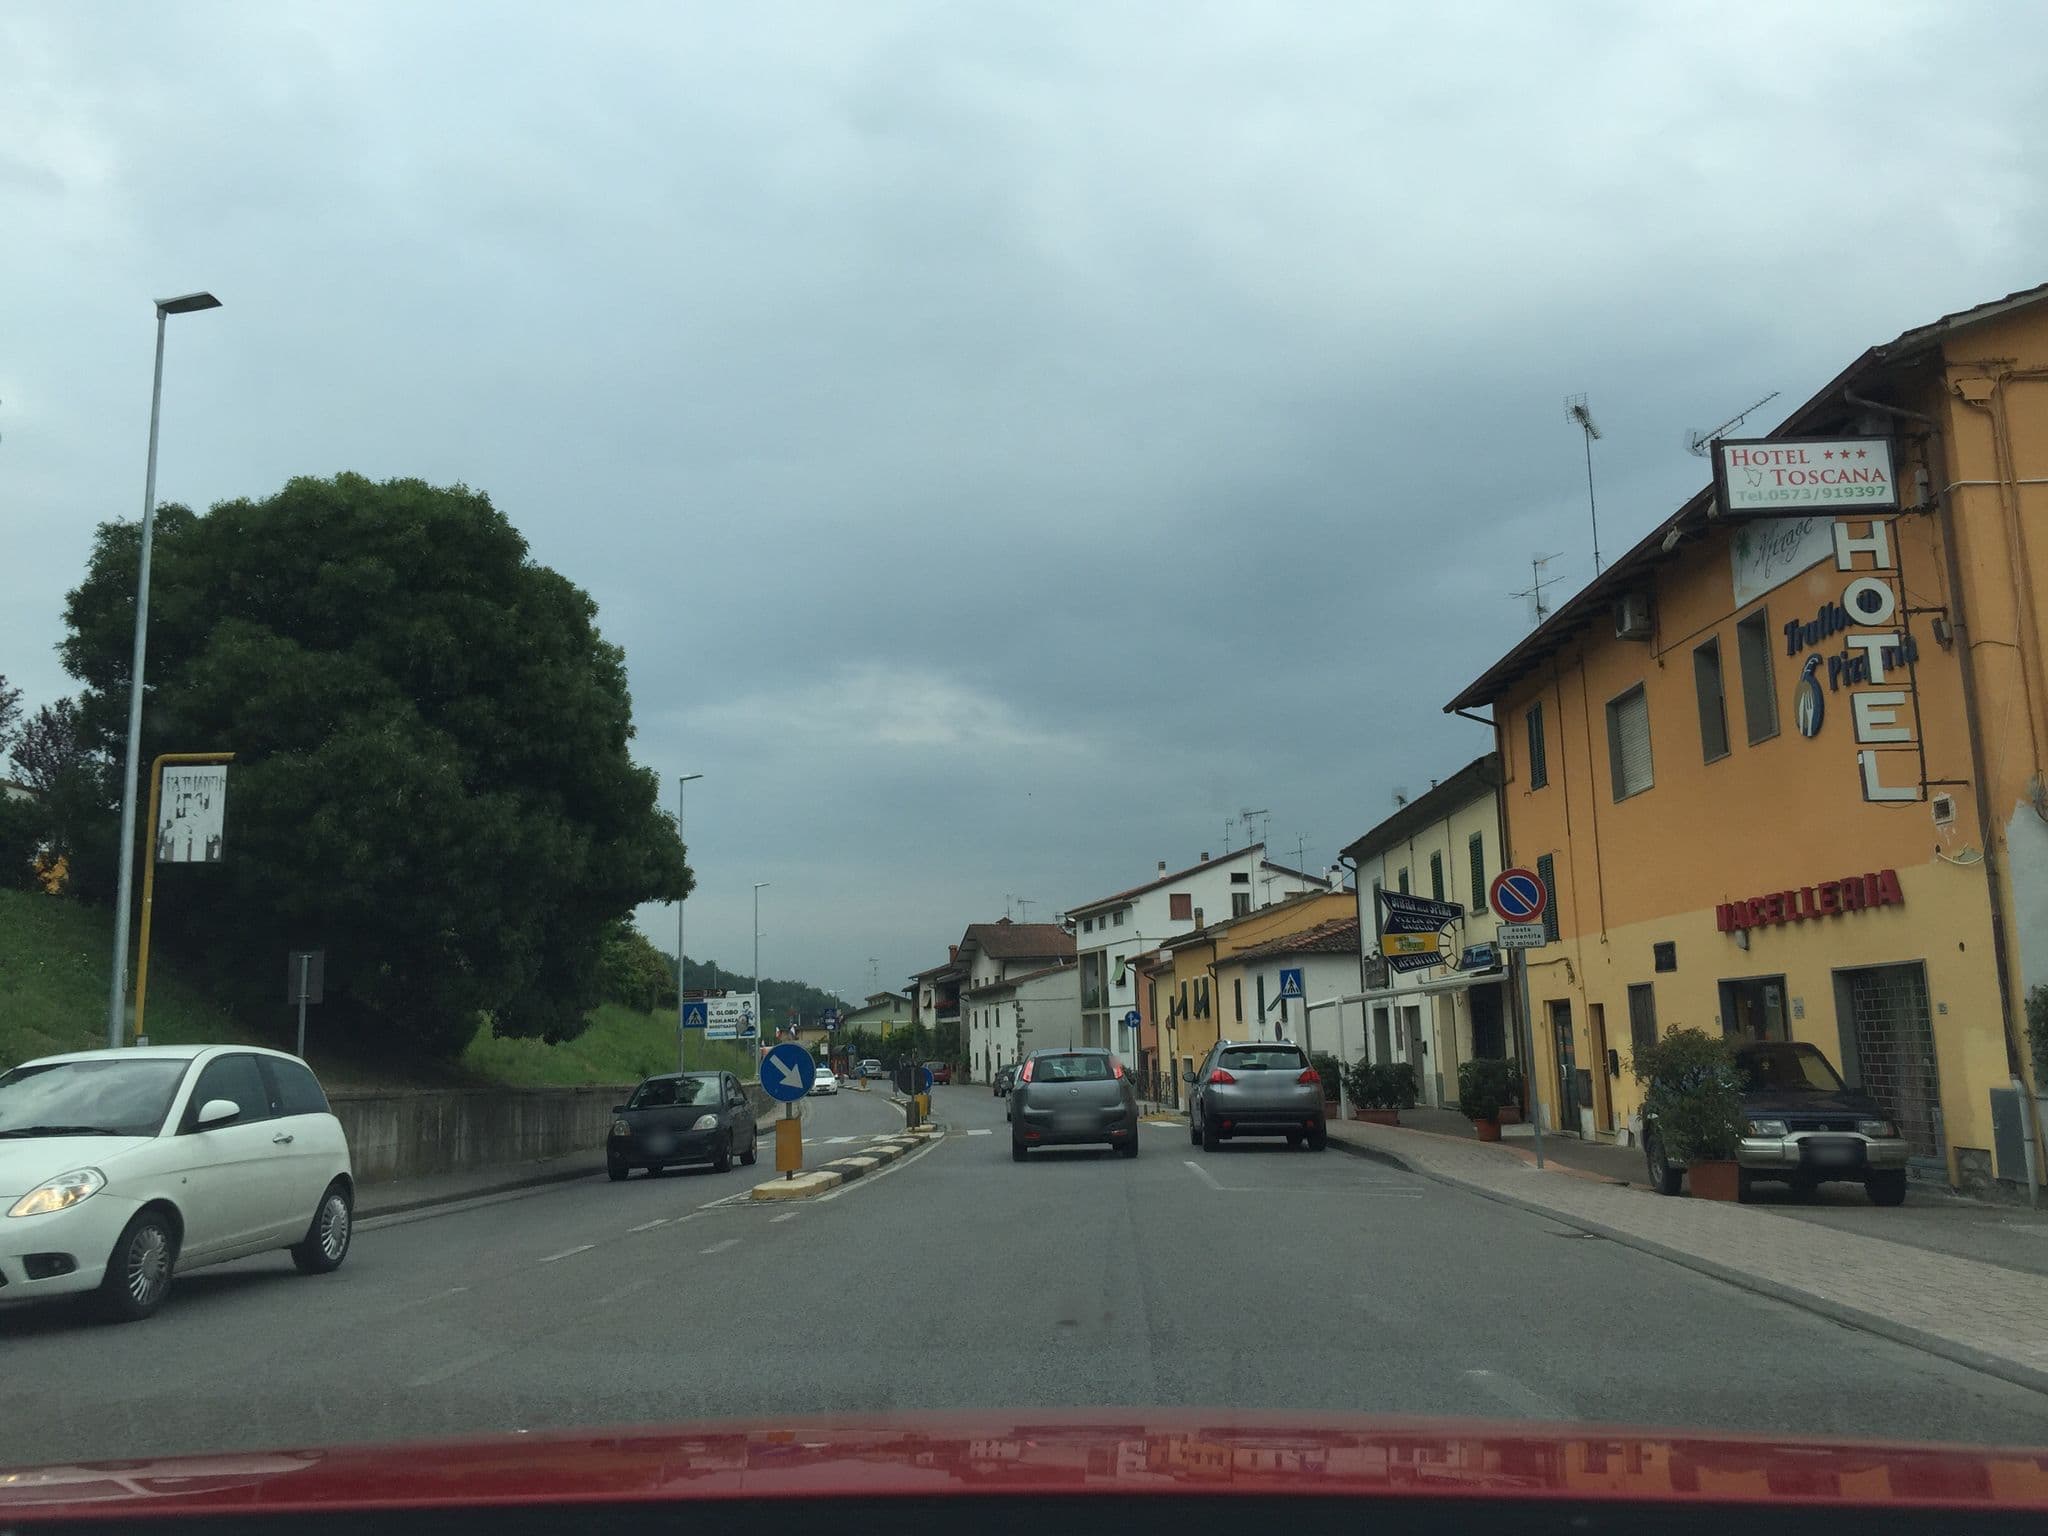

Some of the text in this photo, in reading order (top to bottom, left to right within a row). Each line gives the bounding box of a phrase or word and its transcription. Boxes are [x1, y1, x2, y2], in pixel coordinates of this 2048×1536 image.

[1730, 449, 1810, 466] HOTEL
[1770, 467, 1887, 486] TOSCANA
[1736, 486, 1886, 501] Tel.0573/919397
[1832, 519, 1920, 802] HOTEL
